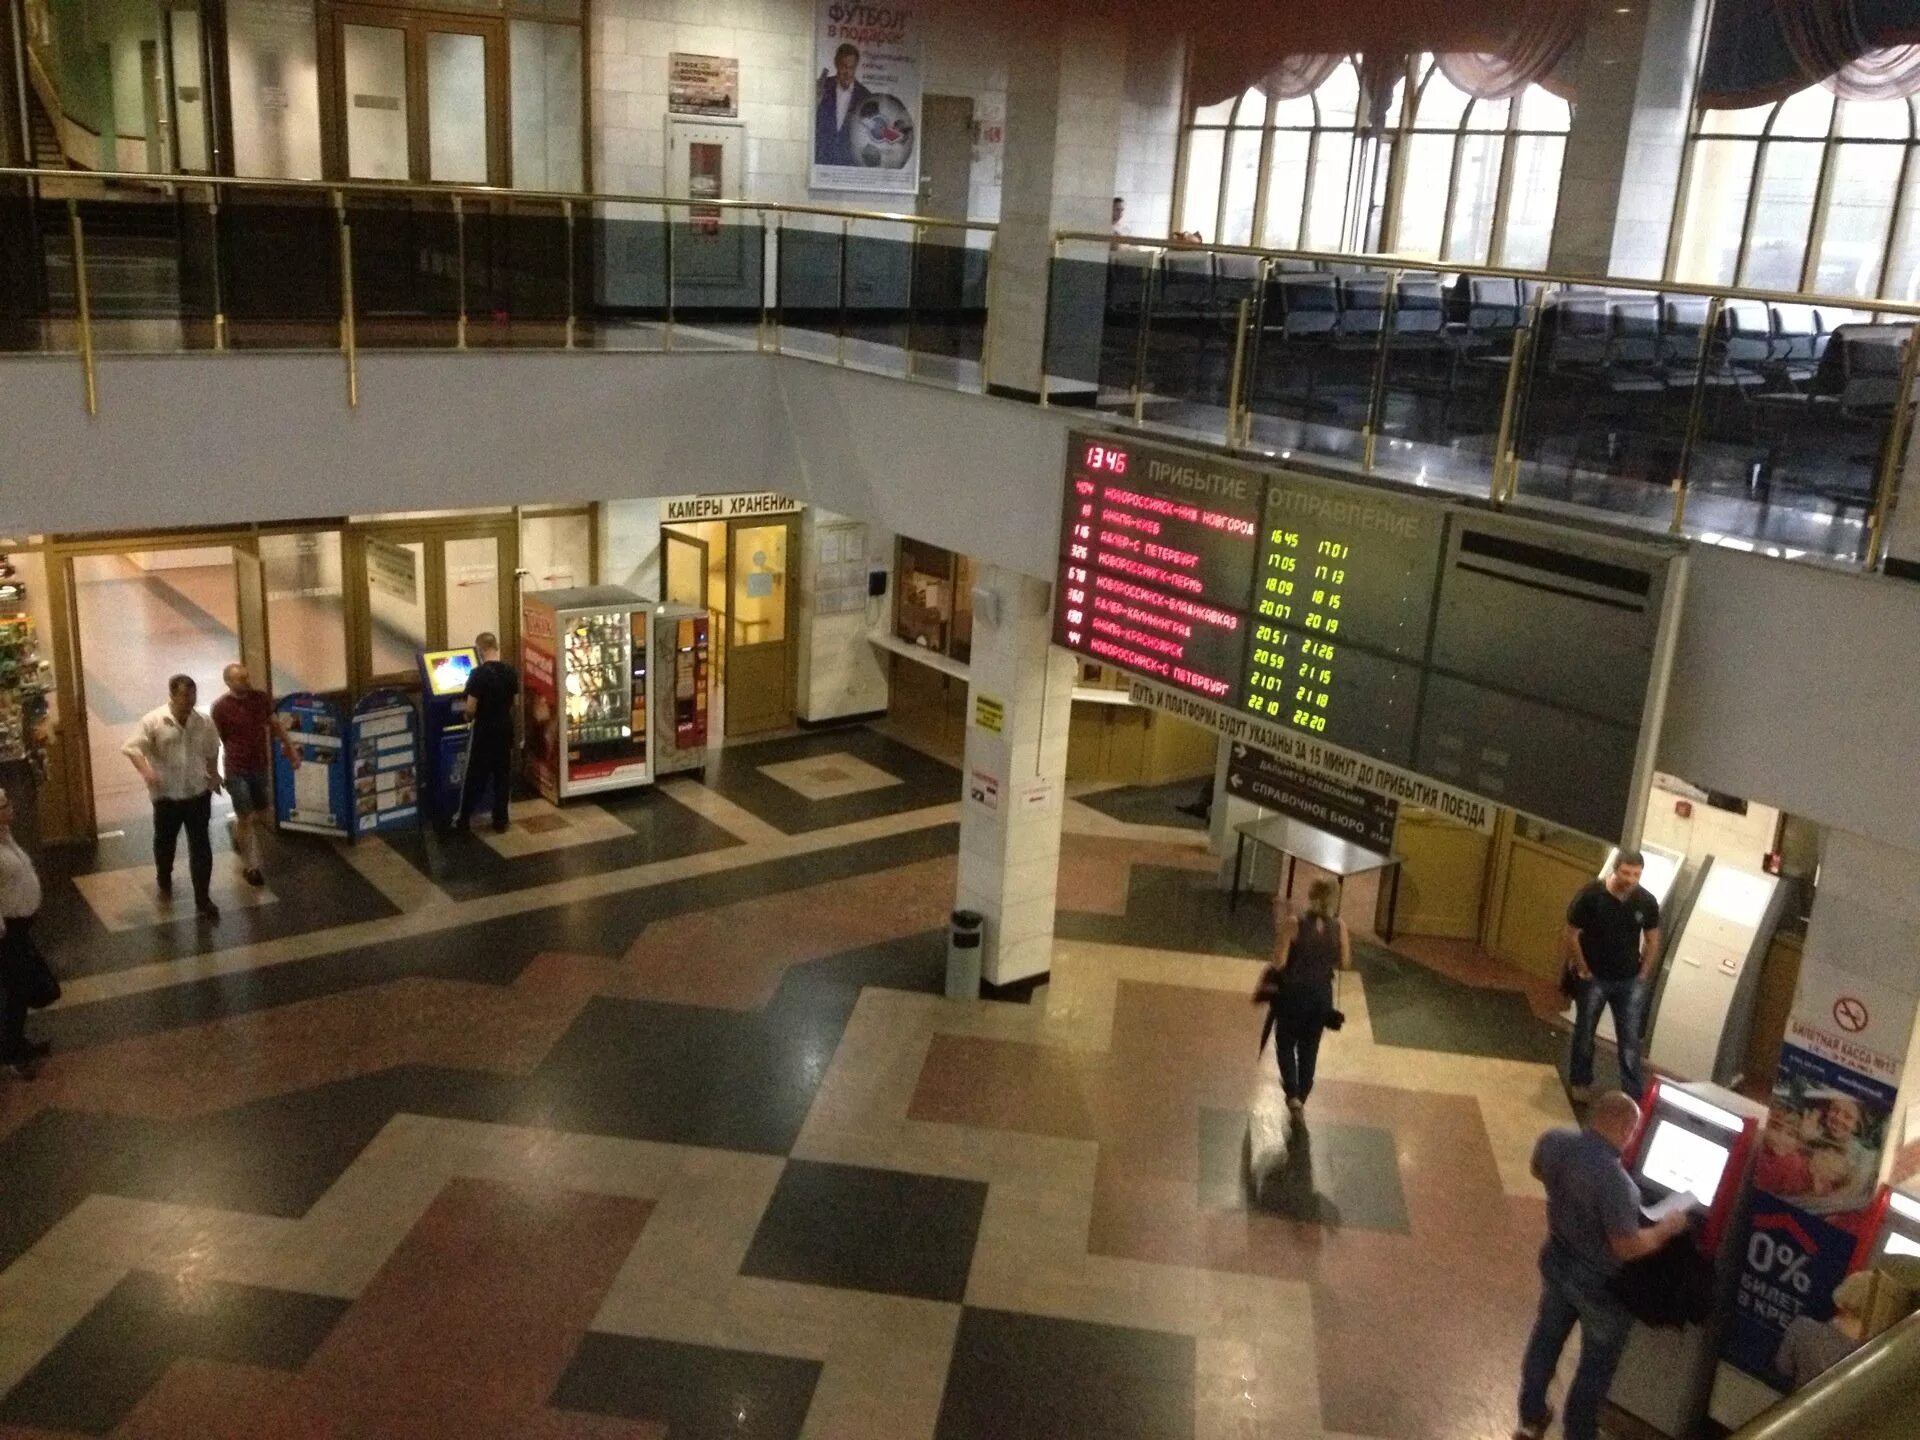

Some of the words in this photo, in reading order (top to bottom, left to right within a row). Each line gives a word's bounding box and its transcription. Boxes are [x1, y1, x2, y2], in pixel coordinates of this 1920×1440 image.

[1150, 461, 1247, 498] ПРИБЫТИЕ
[668, 499, 723, 519] КАМЕРЫ
[730, 495, 795, 514] ХРАНЕНИЯ
[1202, 511, 1256, 536] НОВГОРОД
[1269, 488, 1419, 538] ОТПРАВЛЕНИЕ
[1145, 543, 1200, 568] ПЕТЕРБУРГ
[1174, 667, 1230, 697] ПЕТЕРБУРГ
[1132, 683, 1154, 705] ПУТЬ
[1156, 690, 1164, 707] И
[1219, 713, 1248, 737] БУДУТ
[1249, 724, 1293, 753] УКАЗАНЫ
[1295, 739, 1307, 761] ЗА
[1309, 746, 1321, 765] 15
[1323, 751, 1356, 778] МИНУТ
[1357, 763, 1373, 784] ДО
[1375, 769, 1439, 807] ПРИБЫТИЯ
[1440, 791, 1486, 829] ПОЕЗДА
[1252, 781, 1328, 819] СПРАВОЧНОЕ
[1329, 811, 1365, 834] БЮРО
[1747, 1231, 1811, 1293] 0%
[1754, 1298, 1792, 1329] КРЕ
